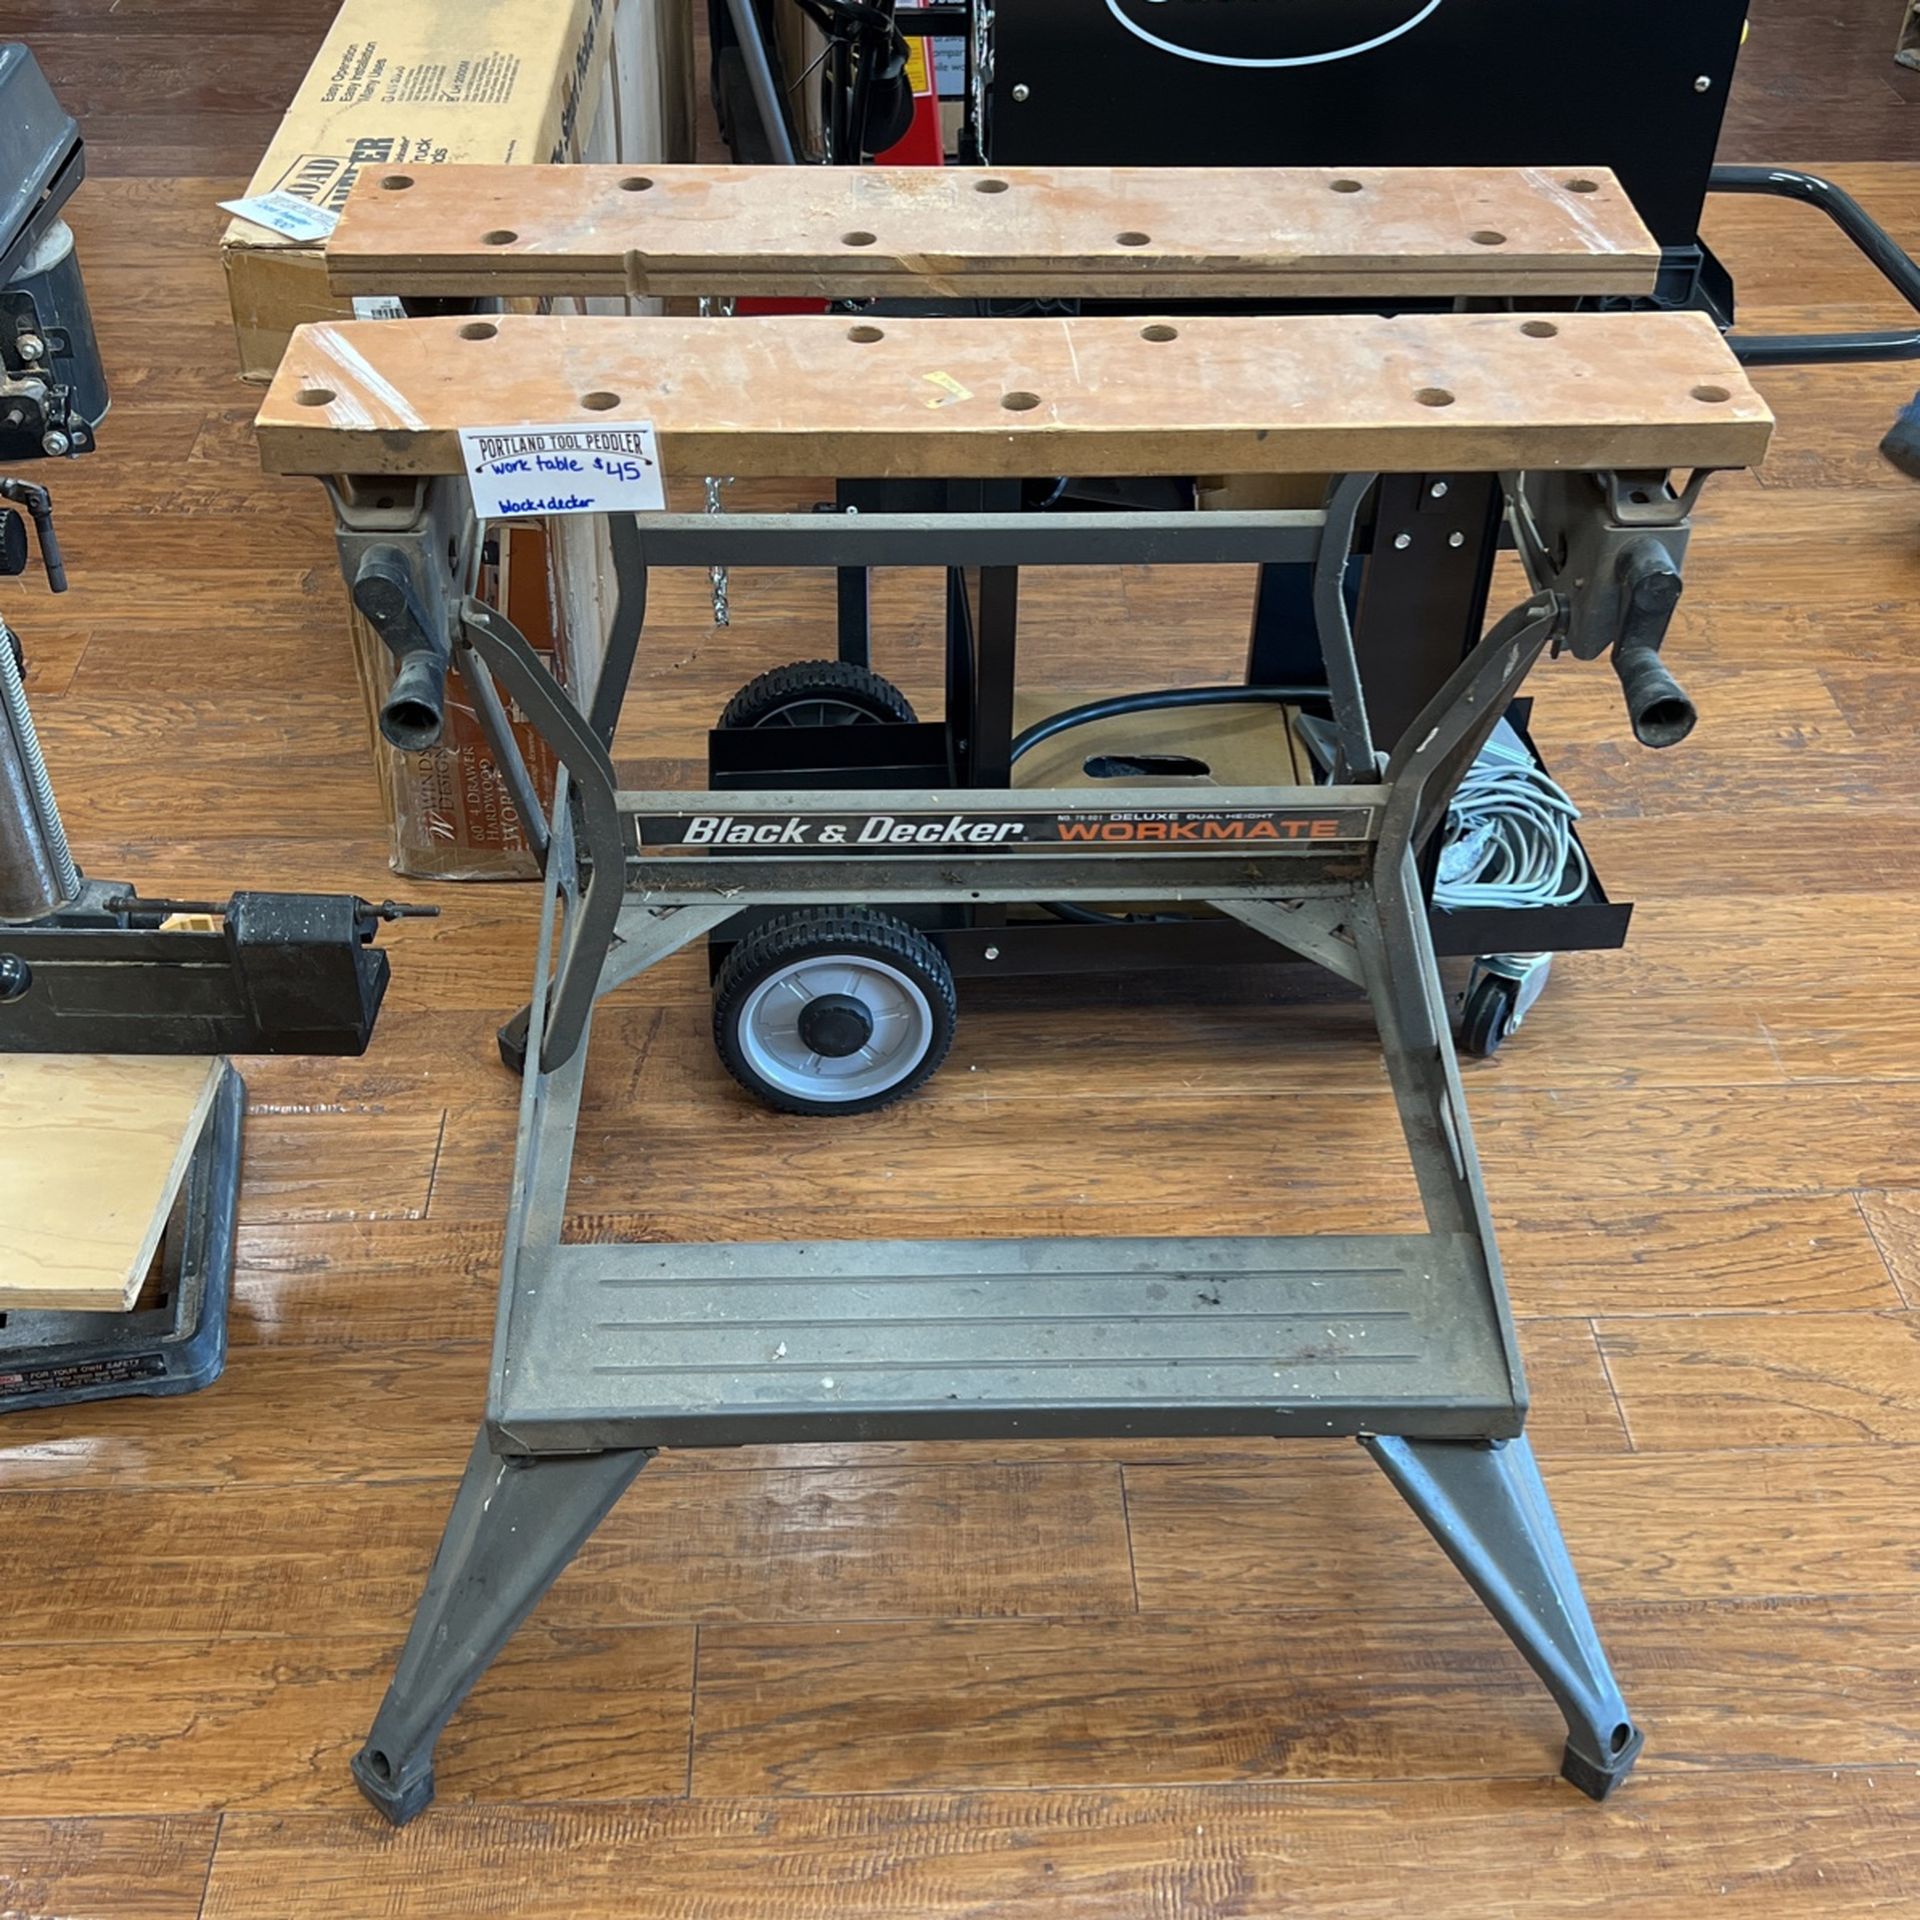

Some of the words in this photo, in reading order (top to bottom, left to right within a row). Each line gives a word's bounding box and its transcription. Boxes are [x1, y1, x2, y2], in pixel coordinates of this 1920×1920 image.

[330, 43, 359, 82] Operation
[348, 41, 378, 81] Installation
[367, 58, 388, 78] Uses
[320, 83, 344, 102] Easy
[338, 82, 362, 102] Easy
[409, 137, 434, 163] ruck
[284, 158, 341, 200] OAD
[479, 435, 546, 461] PORTLAND
[550, 434, 582, 451] TOOL
[586, 432, 644, 455] PEDDLER
[491, 458, 532, 475] work
[536, 454, 584, 473] table
[418, 750, 438, 811] WINDS
[462, 746, 481, 805] DRAWER
[479, 758, 500, 841] HARDWOOD
[682, 815, 812, 844] Black
[818, 824, 848, 844] &
[856, 815, 1026, 844] Decker
[1057, 819, 1340, 841] WORKMATE
[1110, 812, 1179, 821] DELUXE
[1225, 812, 1275, 820] HEIGHT
[30, 1371, 49, 1380] FOR
[106, 1359, 140, 1369] SAFETY
